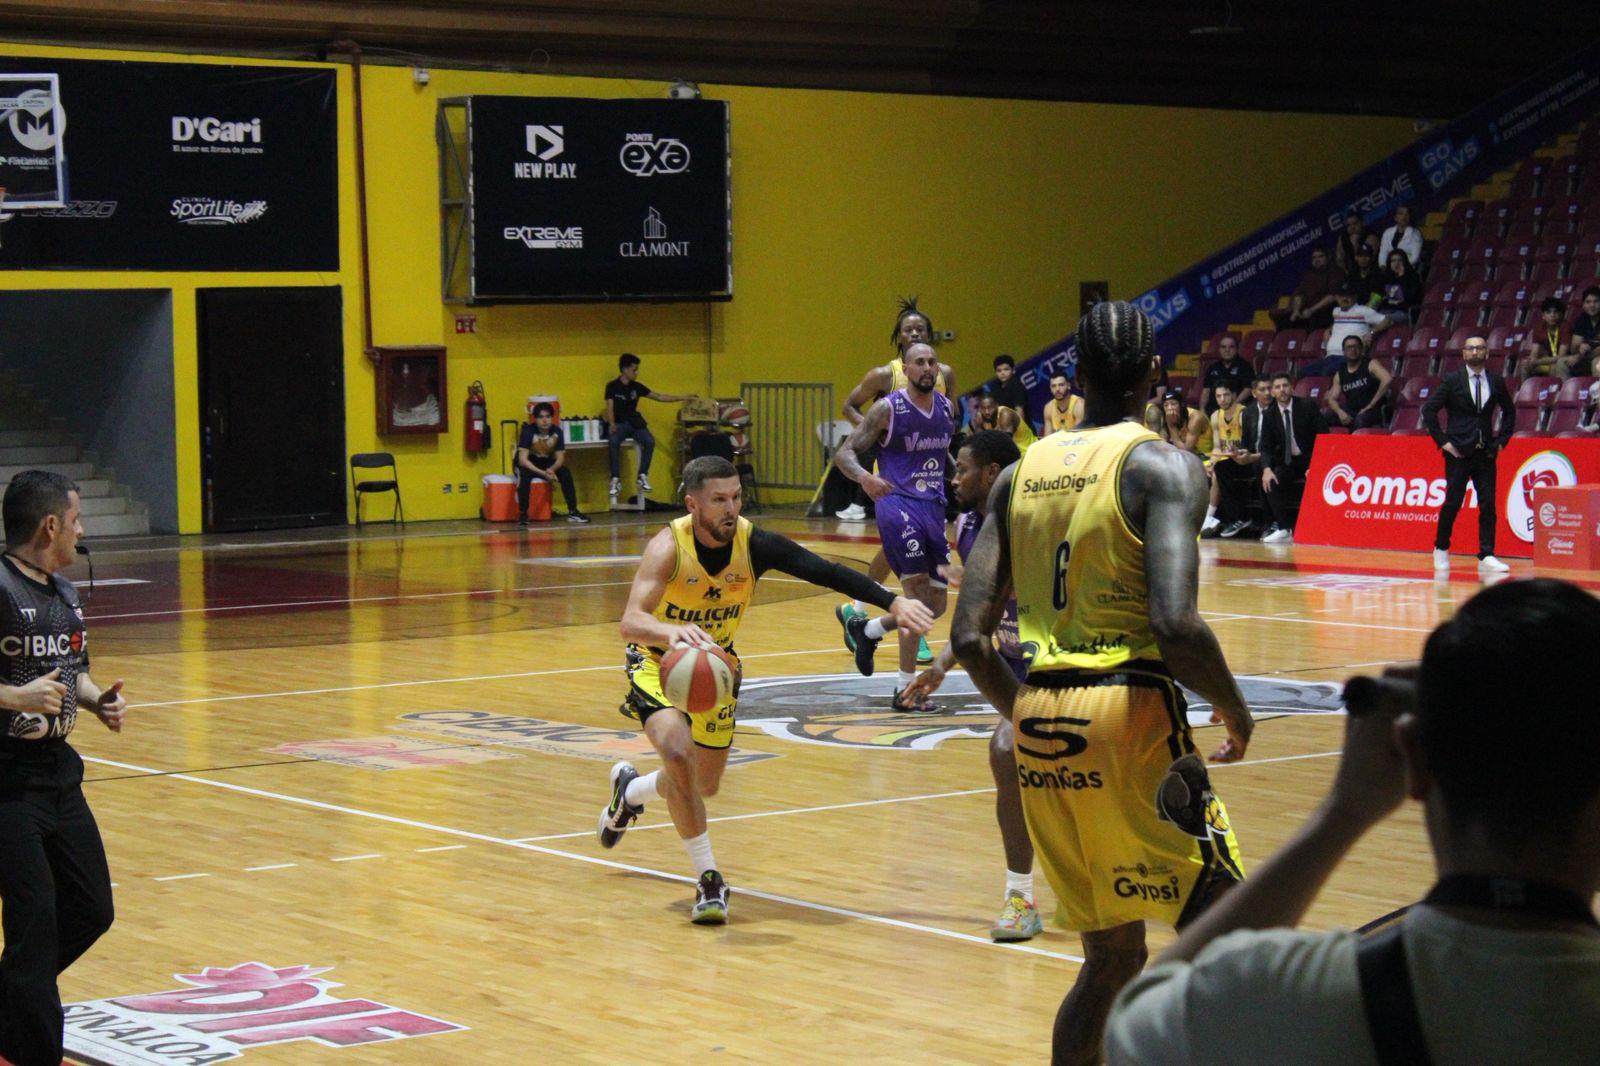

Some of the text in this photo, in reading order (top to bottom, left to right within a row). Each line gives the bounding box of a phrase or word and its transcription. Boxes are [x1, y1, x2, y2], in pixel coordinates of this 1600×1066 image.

[172, 116, 262, 143] D'Gari
[625, 133, 654, 142] PONTE
[1420, 142, 1453, 170] GO
[514, 162, 577, 179] NEW PLAY
[170, 199, 243, 219] SportLife
[503, 226, 583, 240] EXTREME
[555, 240, 583, 248] GYM
[619, 241, 691, 257] CLAMONT
[1216, 264, 1258, 295] EXTREME
[1258, 251, 1280, 271] GYM
[1344, 509, 1440, 523] COLOR MÁS INNOVACIÓ
[1053, 540, 1071, 612] 6
[1113, 876, 1181, 903] Gypsi
[105, 981, 462, 1046] DIF
